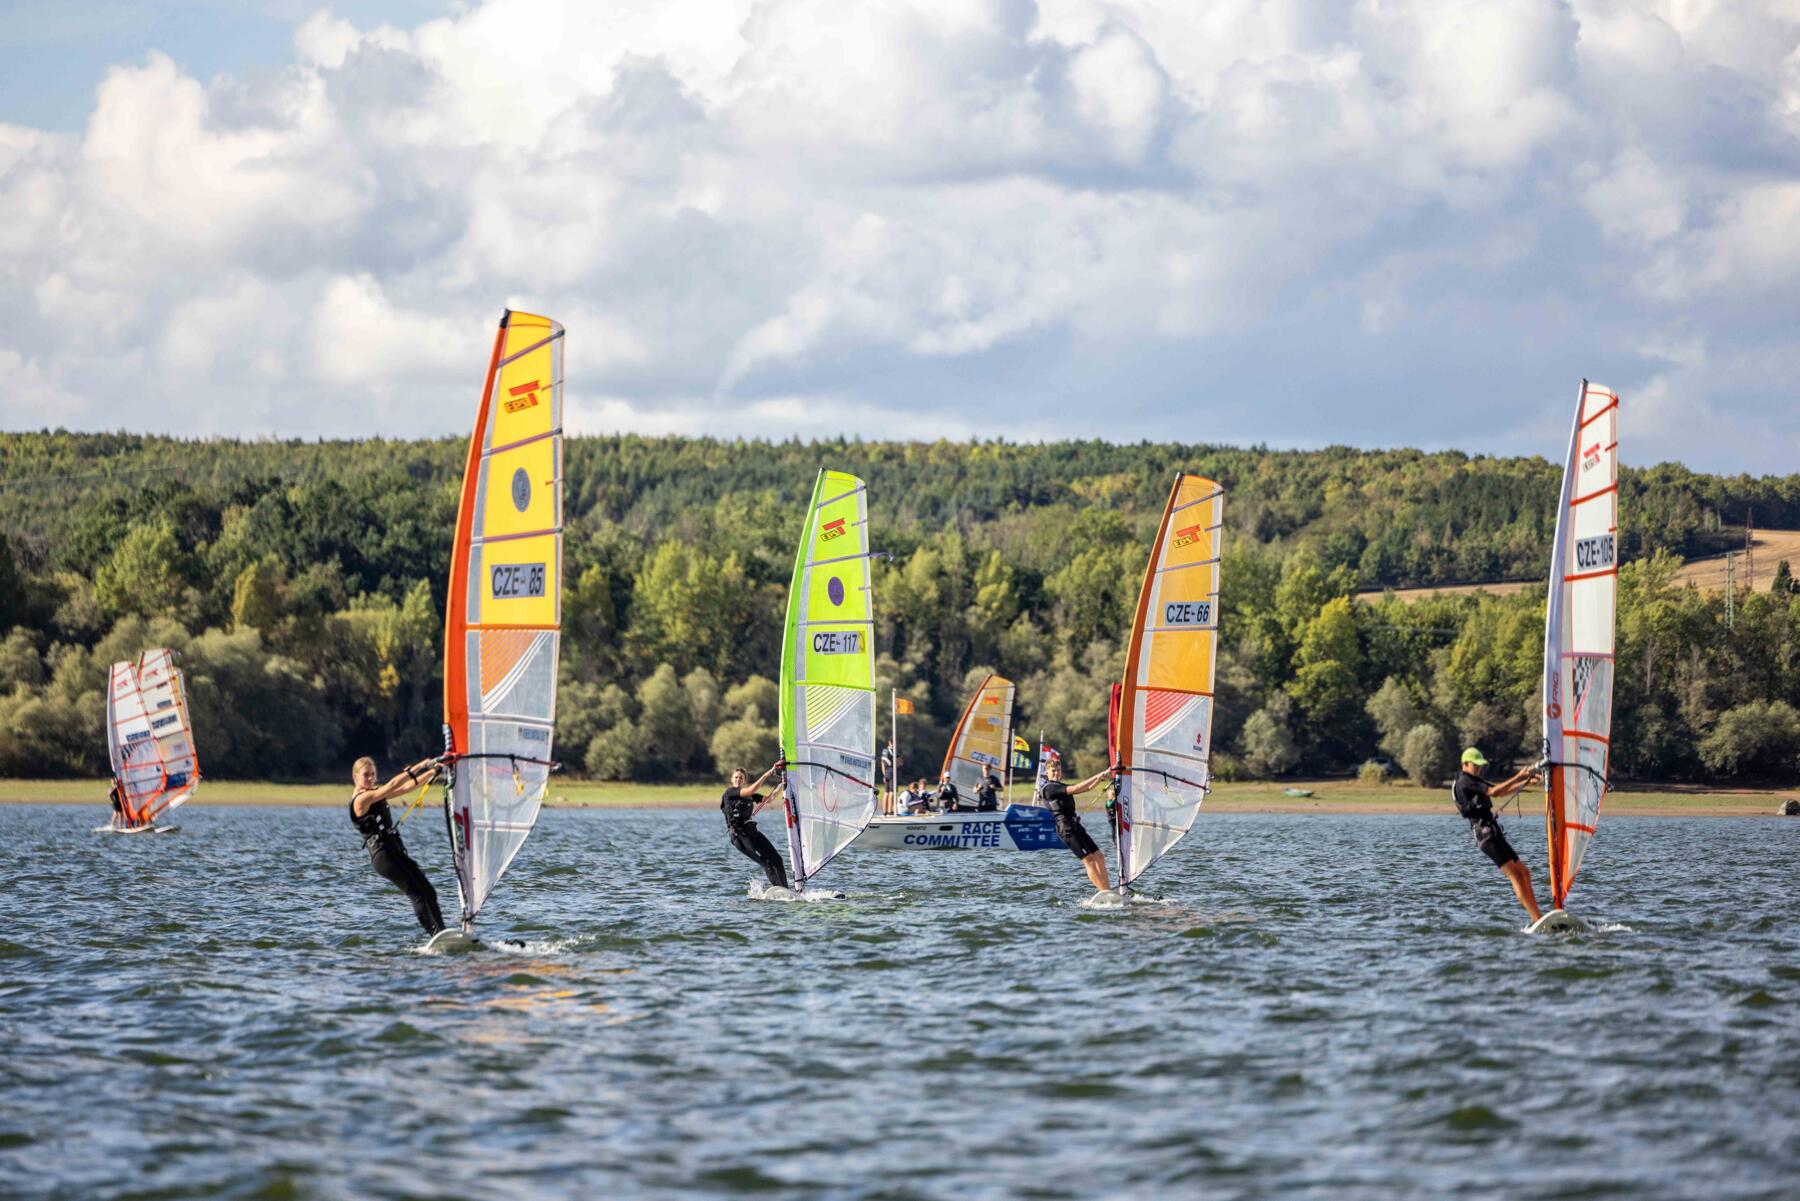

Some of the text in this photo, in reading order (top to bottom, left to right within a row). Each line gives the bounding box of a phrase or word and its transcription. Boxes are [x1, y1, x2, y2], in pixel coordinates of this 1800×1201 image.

[1576, 538, 1614, 566] CZE-105
[1166, 604, 1210, 622] CZE-66
[962, 822, 1000, 834] RACE
[904, 834, 1000, 847] COMMITTEE
